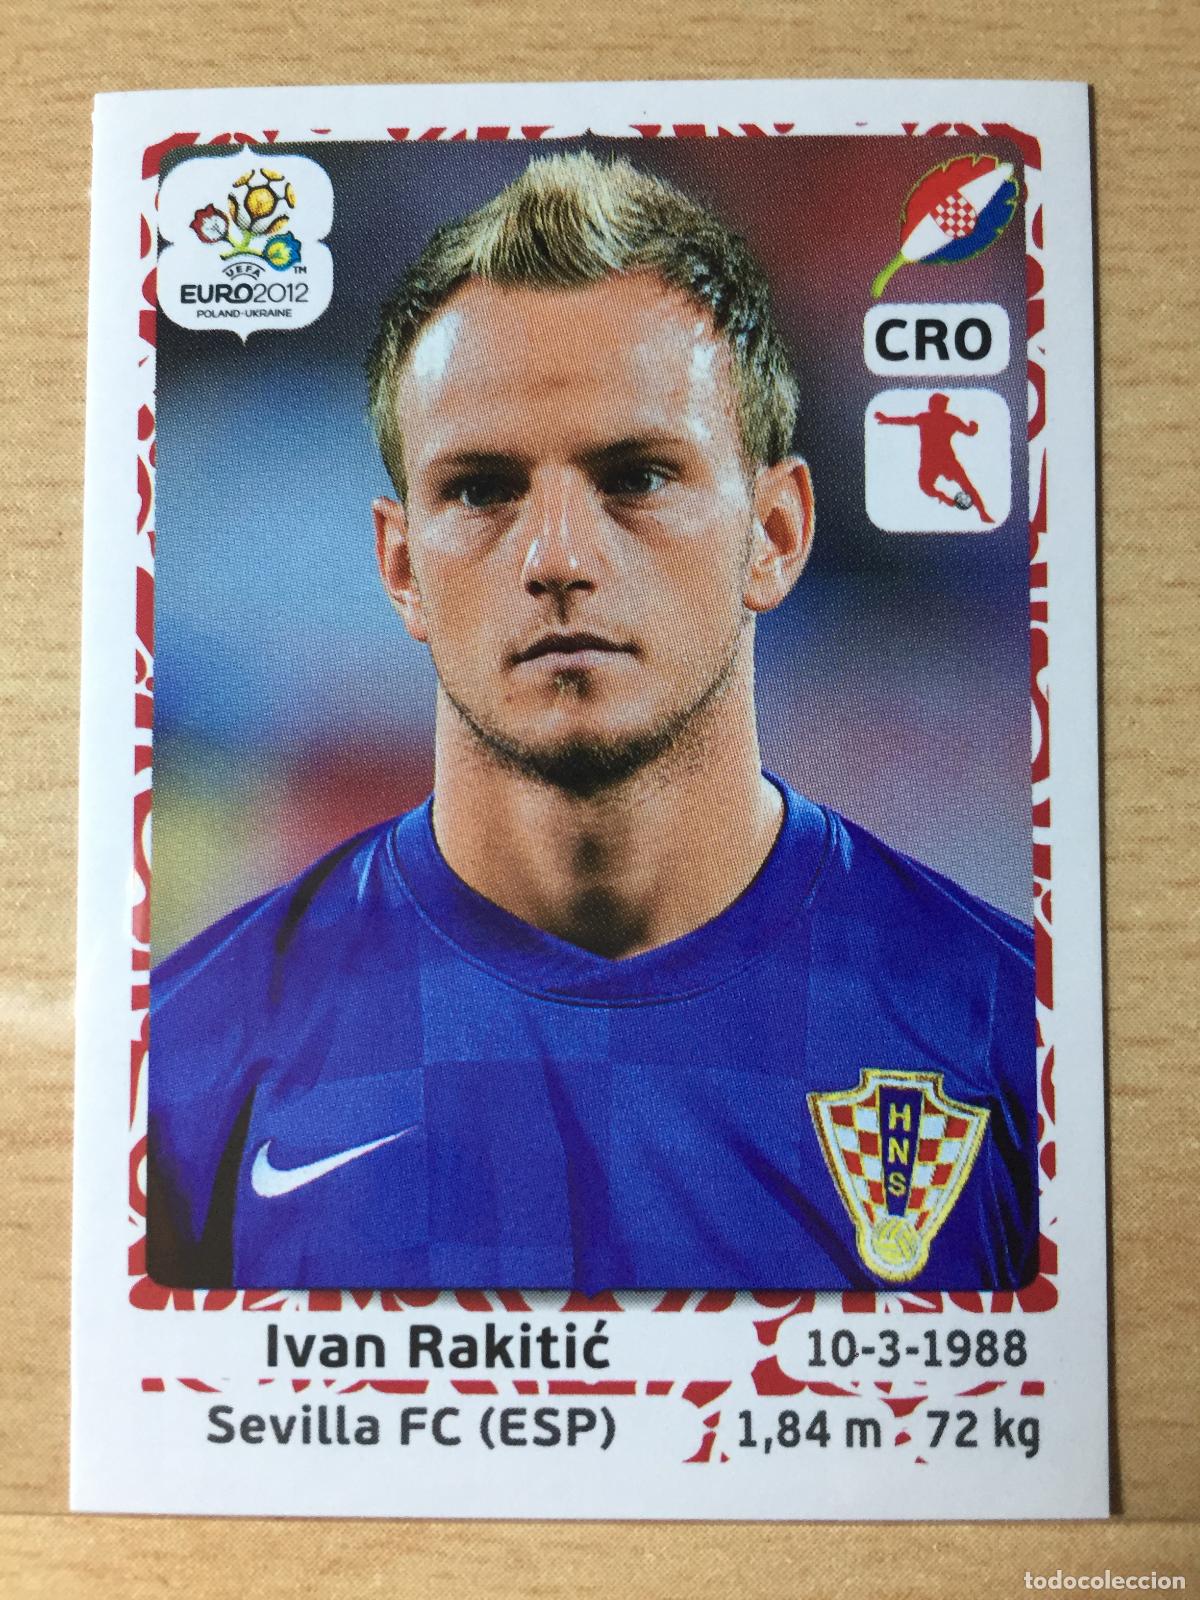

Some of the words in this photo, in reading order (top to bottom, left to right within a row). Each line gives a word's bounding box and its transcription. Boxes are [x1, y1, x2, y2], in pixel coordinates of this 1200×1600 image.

[180, 282, 309, 304] EURO2012
[225, 265, 261, 278] UEFA
[196, 308, 293, 318] POLAND-UKRAINE
[875, 317, 992, 362] CRO
[888, 1103, 911, 1197] HNS
[266, 1323, 386, 1368] Ivan
[409, 1318, 610, 1369] Rakitić
[807, 1328, 1028, 1368] 10-3-1988
[206, 1403, 380, 1445] Sevilla
[400, 1406, 462, 1446] FC
[479, 1406, 616, 1451] (ESP)
[738, 1409, 831, 1455] 1,84
[846, 1416, 881, 1448] m
[926, 1409, 978, 1449] 72
[994, 1407, 1040, 1459] kg
